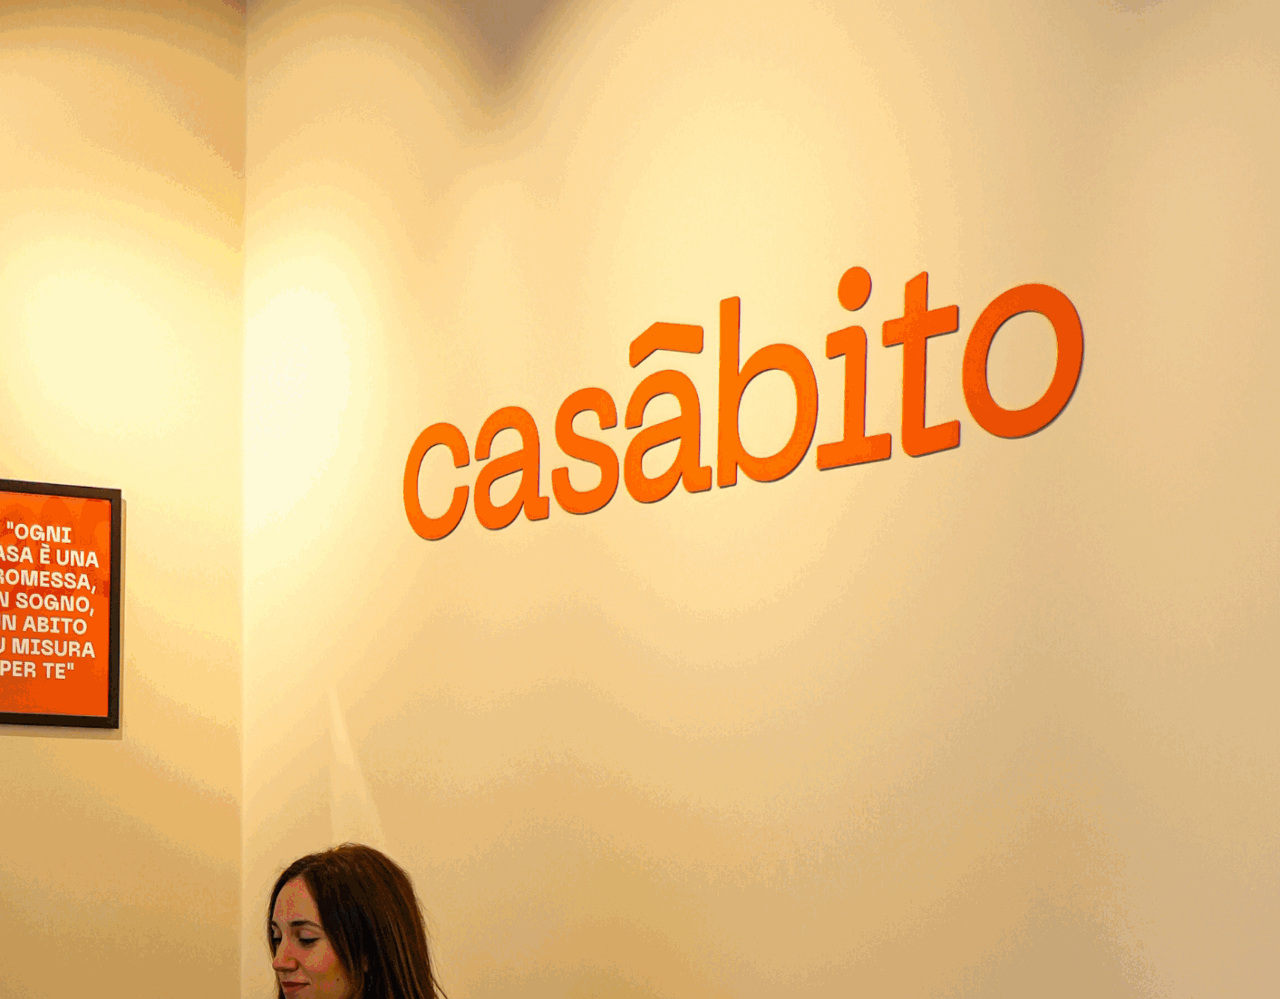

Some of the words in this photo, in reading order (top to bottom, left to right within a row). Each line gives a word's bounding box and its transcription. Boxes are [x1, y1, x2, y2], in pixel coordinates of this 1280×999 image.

[402, 266, 1084, 541] casâbito
[6, 521, 72, 544] "OGNI
[39, 542, 51, 565] È
[56, 549, 100, 569] UNA
[15, 592, 94, 617] SOGNO,
[22, 615, 88, 635] ABITO
[11, 637, 96, 659] MISURA
[0, 659, 36, 678] PER
[42, 661, 74, 680] TE"
